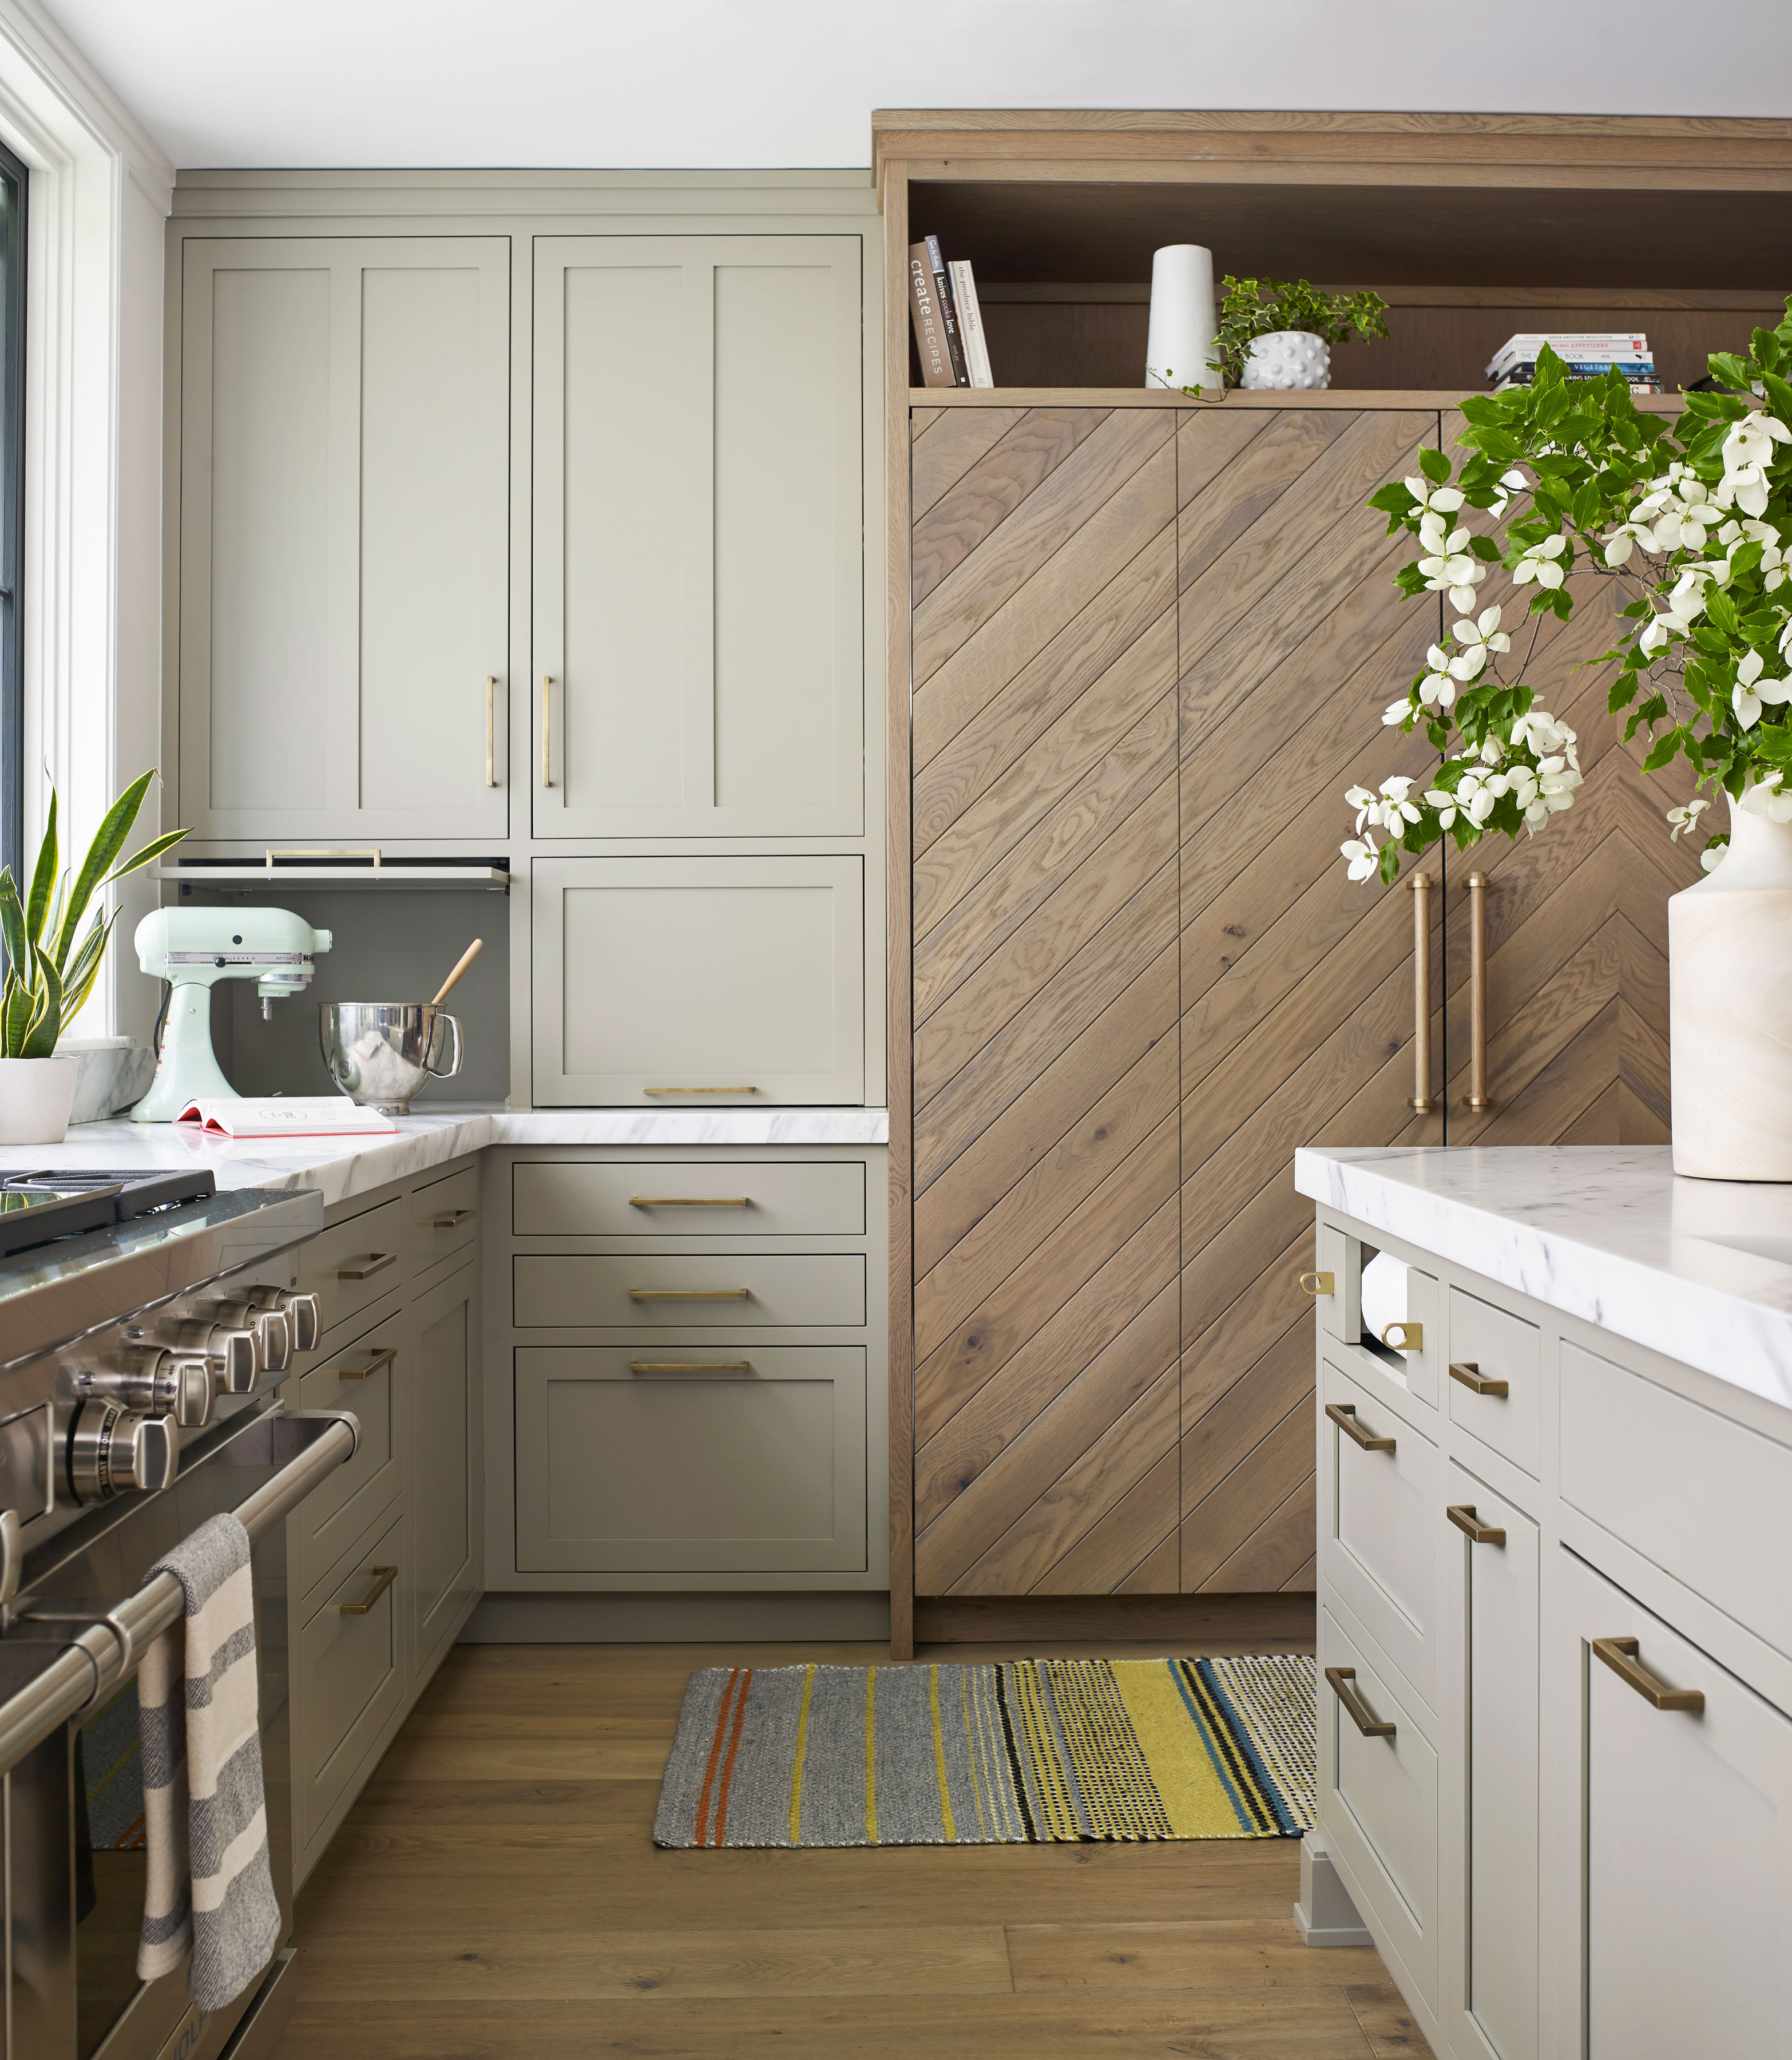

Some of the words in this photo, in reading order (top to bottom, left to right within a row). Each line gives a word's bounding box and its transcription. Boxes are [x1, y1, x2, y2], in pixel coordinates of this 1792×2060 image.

[937, 277, 946, 299] knives
[911, 260, 931, 315] create
[923, 318, 942, 374] RECIPES
[942, 299, 951, 318] cooks
[960, 281, 970, 310] produce
[967, 312, 975, 332] bible
[946, 319, 954, 334] love
[105, 1409, 118, 1427] BAKE
[100, 1432, 110, 1455] BROIL
[99, 1462, 109, 1485] ROAST
